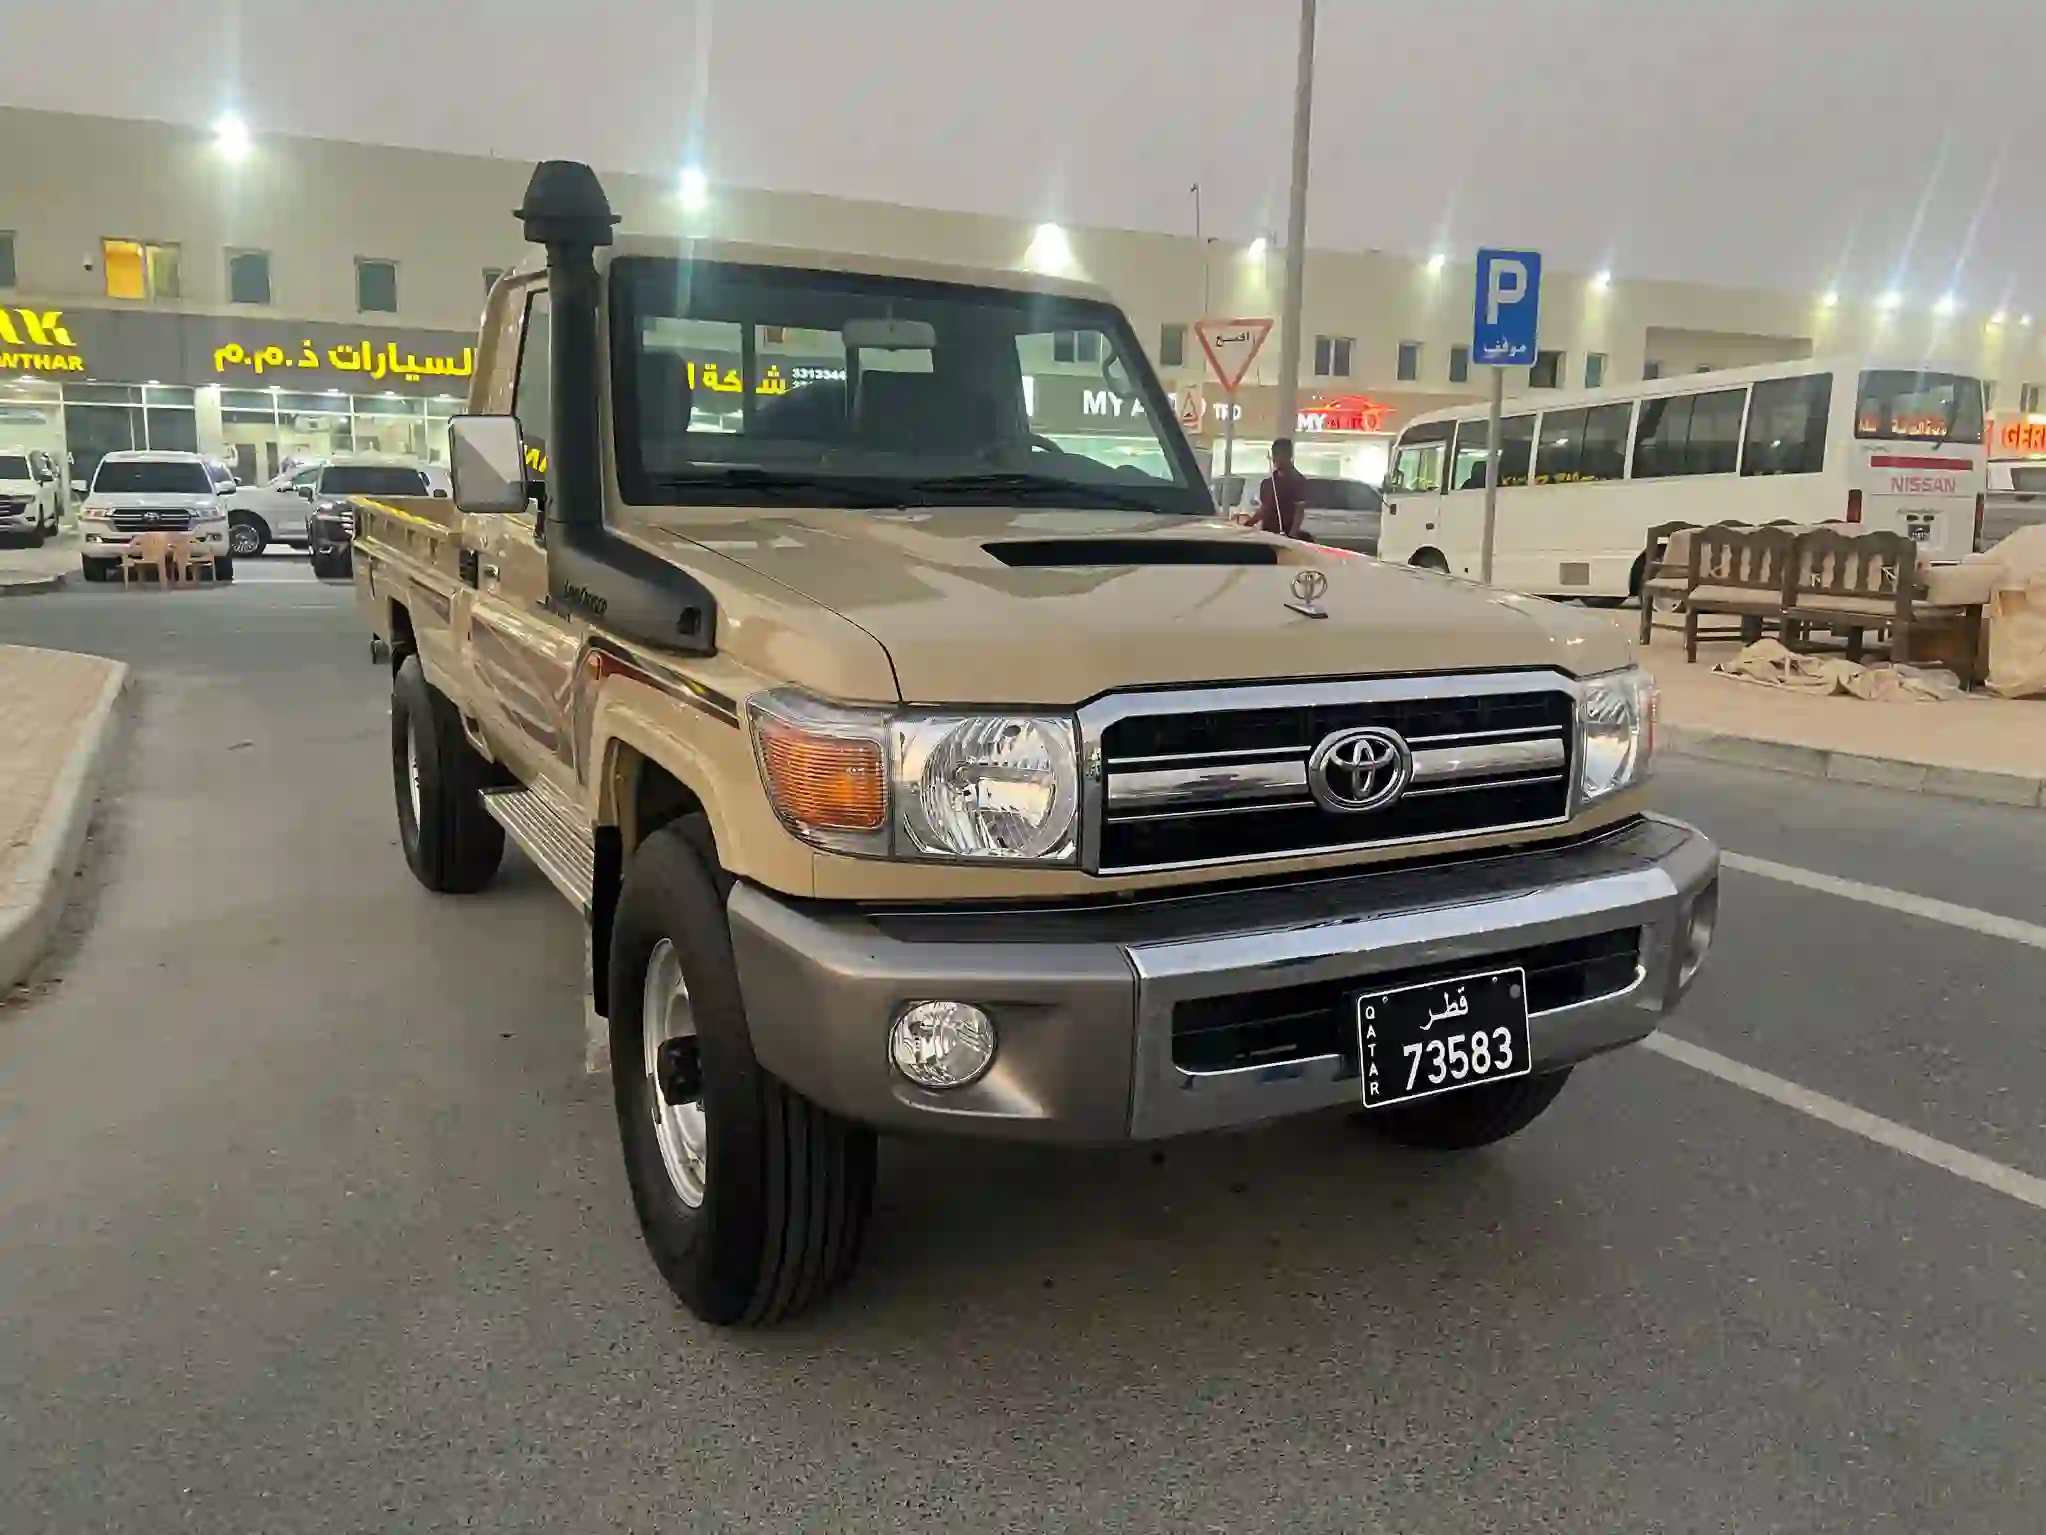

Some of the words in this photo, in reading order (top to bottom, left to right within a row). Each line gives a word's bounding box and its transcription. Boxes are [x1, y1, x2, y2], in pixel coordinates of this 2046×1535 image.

[1487, 259, 1527, 324] P
[328, 340, 478, 382] لسيارات
[1083, 390, 1123, 417] MY
[1297, 412, 1327, 432] MY
[1891, 476, 1956, 494] NISSAN
[1419, 986, 1469, 1031] قطر
[1365, 1005, 1380, 1096] QATAR
[1403, 1026, 1514, 1091] 73583
